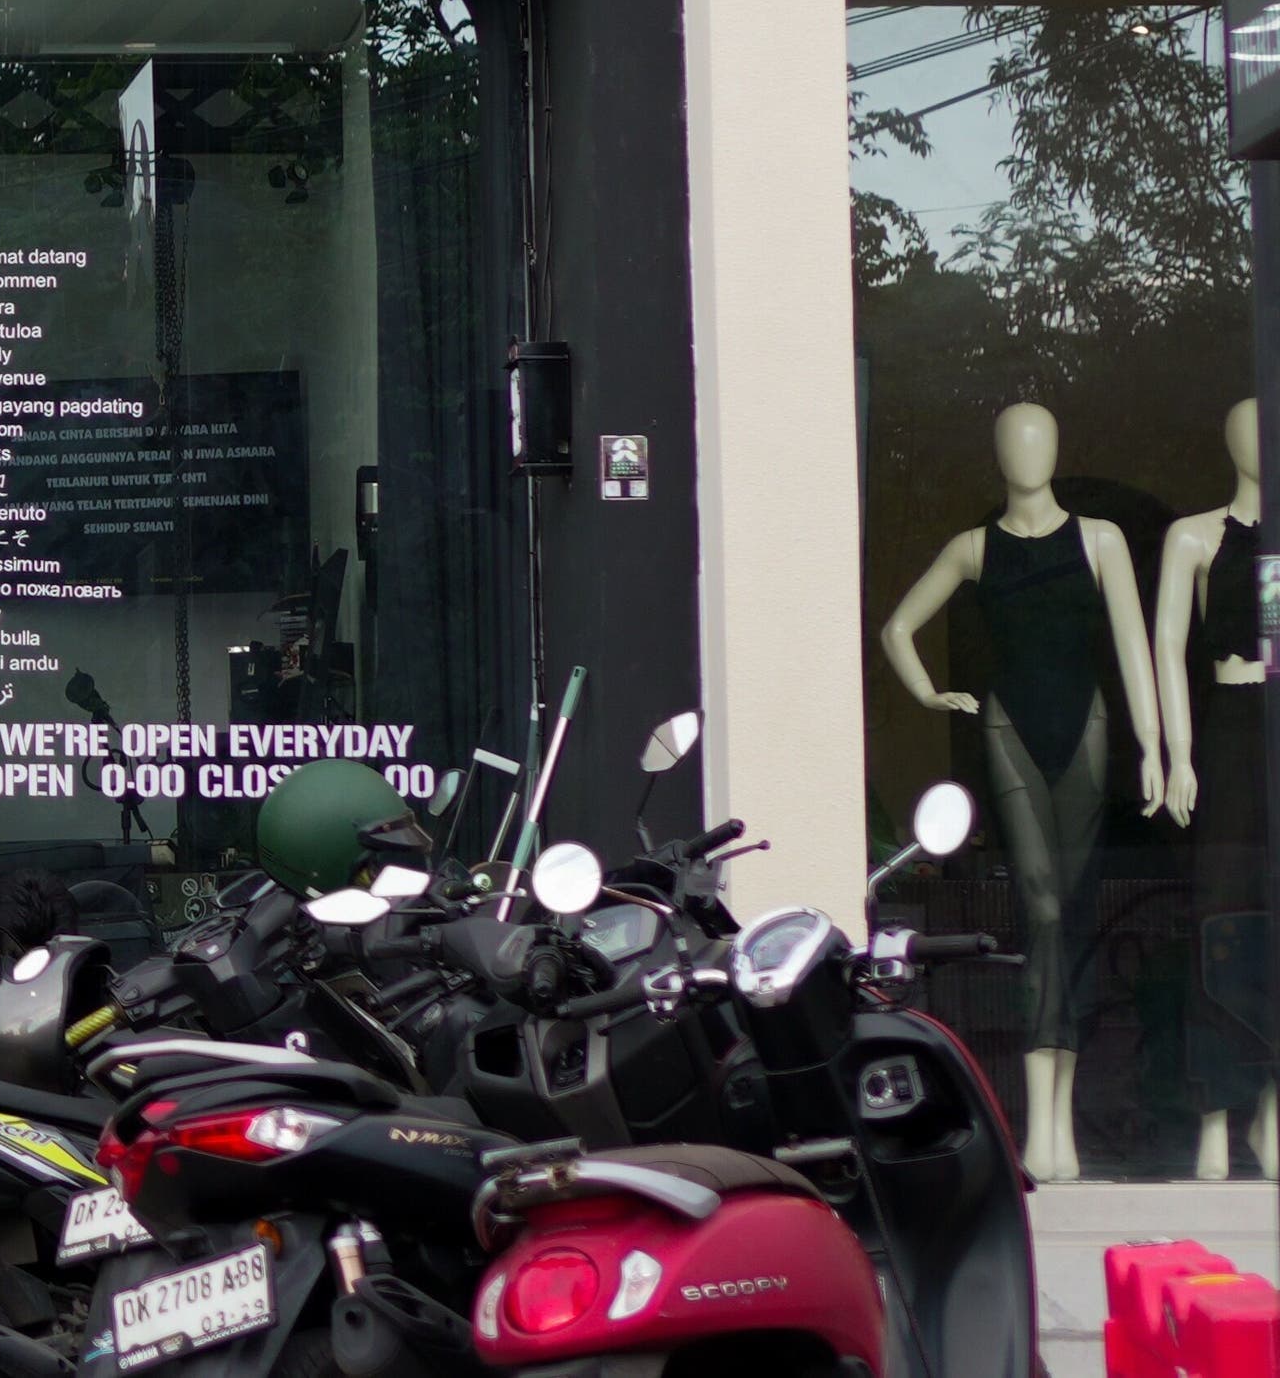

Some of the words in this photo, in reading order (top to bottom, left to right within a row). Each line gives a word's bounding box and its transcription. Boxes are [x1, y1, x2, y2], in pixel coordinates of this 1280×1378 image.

[28, 249, 86, 267] datang
[60, 399, 143, 417] pagdating
[59, 428, 92, 440] CINTA
[95, 427, 142, 439] BERSEMI
[211, 423, 237, 434] KITA
[61, 451, 135, 464] ANGGUNNYA
[196, 447, 223, 460] JIWA
[226, 445, 276, 458] ASMARA
[46, 476, 109, 488] TERLANJUR
[111, 475, 150, 487] UNTUK
[77, 498, 111, 510] TELAH
[182, 495, 241, 507] SEMENJAK
[243, 493, 269, 505] DINI
[83, 523, 131, 534] SEHIDUP
[133, 521, 174, 533] SEMATI
[17, 582, 122, 598] пожаловать
[0, 630, 40, 646] bulla
[9, 656, 58, 671] amdu
[122, 722, 216, 757] OPEN
[229, 724, 414, 758] EVERYDAY
[199, 763, 304, 798] CLOS
[157, 1272, 212, 1315] 2708
